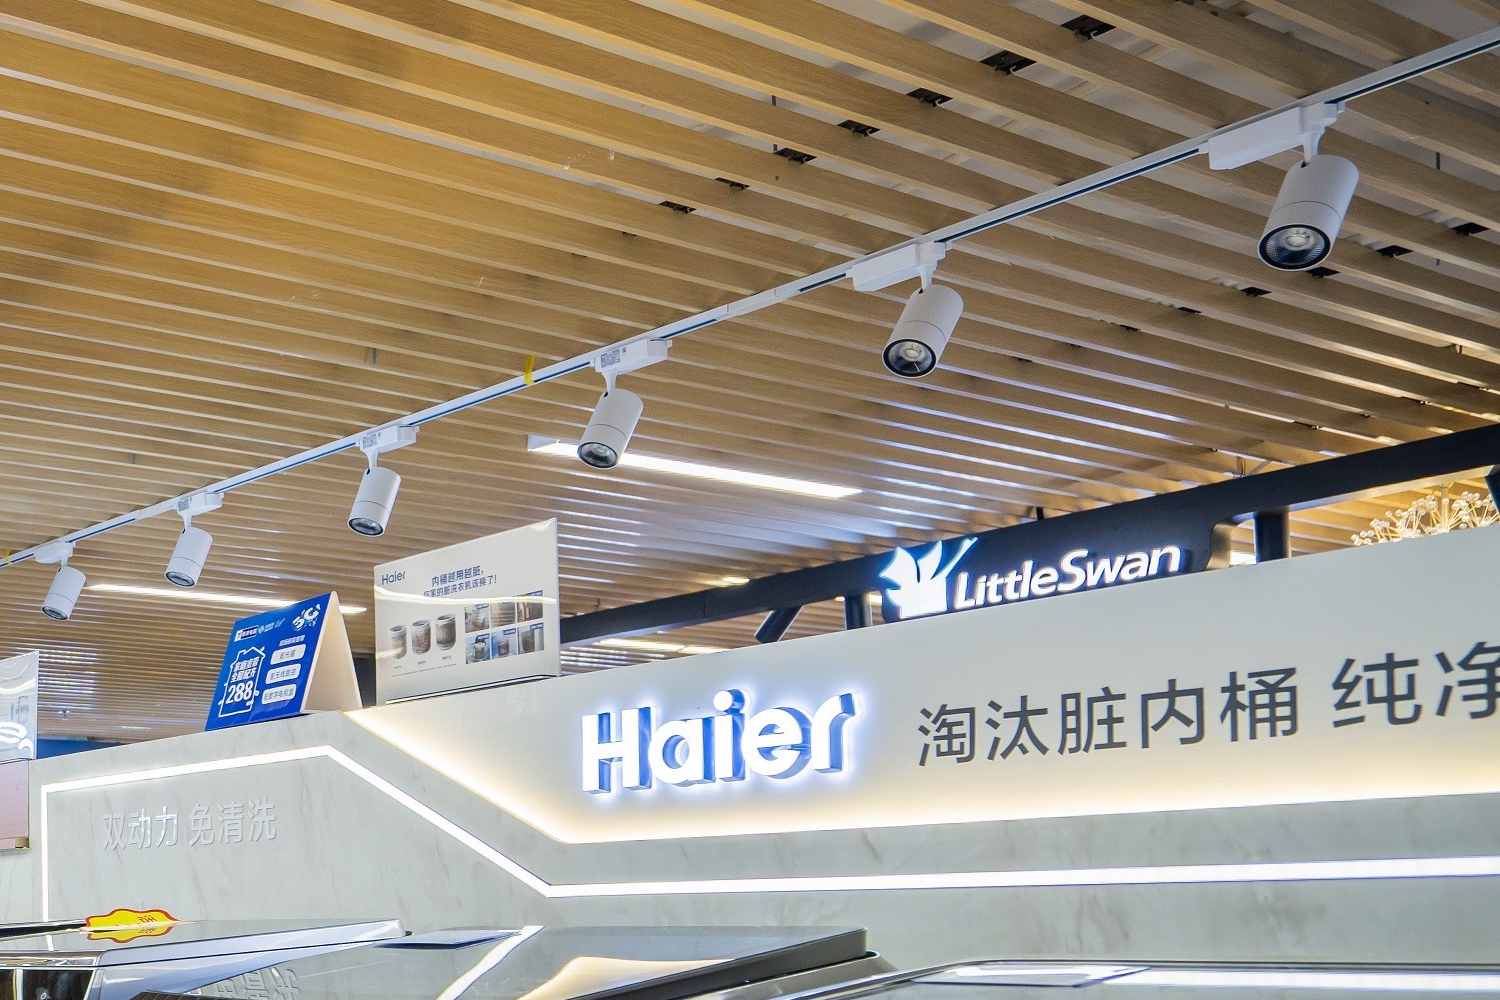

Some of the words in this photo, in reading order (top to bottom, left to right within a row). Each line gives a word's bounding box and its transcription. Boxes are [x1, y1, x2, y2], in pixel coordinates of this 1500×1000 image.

[381, 569, 406, 586] Haier
[955, 545, 1182, 610] LittleSwan
[225, 681, 254, 705] 288
[918, 666, 1301, 769] 淘汰脏内桶
[581, 689, 857, 794] Haier
[102, 804, 178, 852] 双动力
[188, 795, 277, 848] 免清洗
